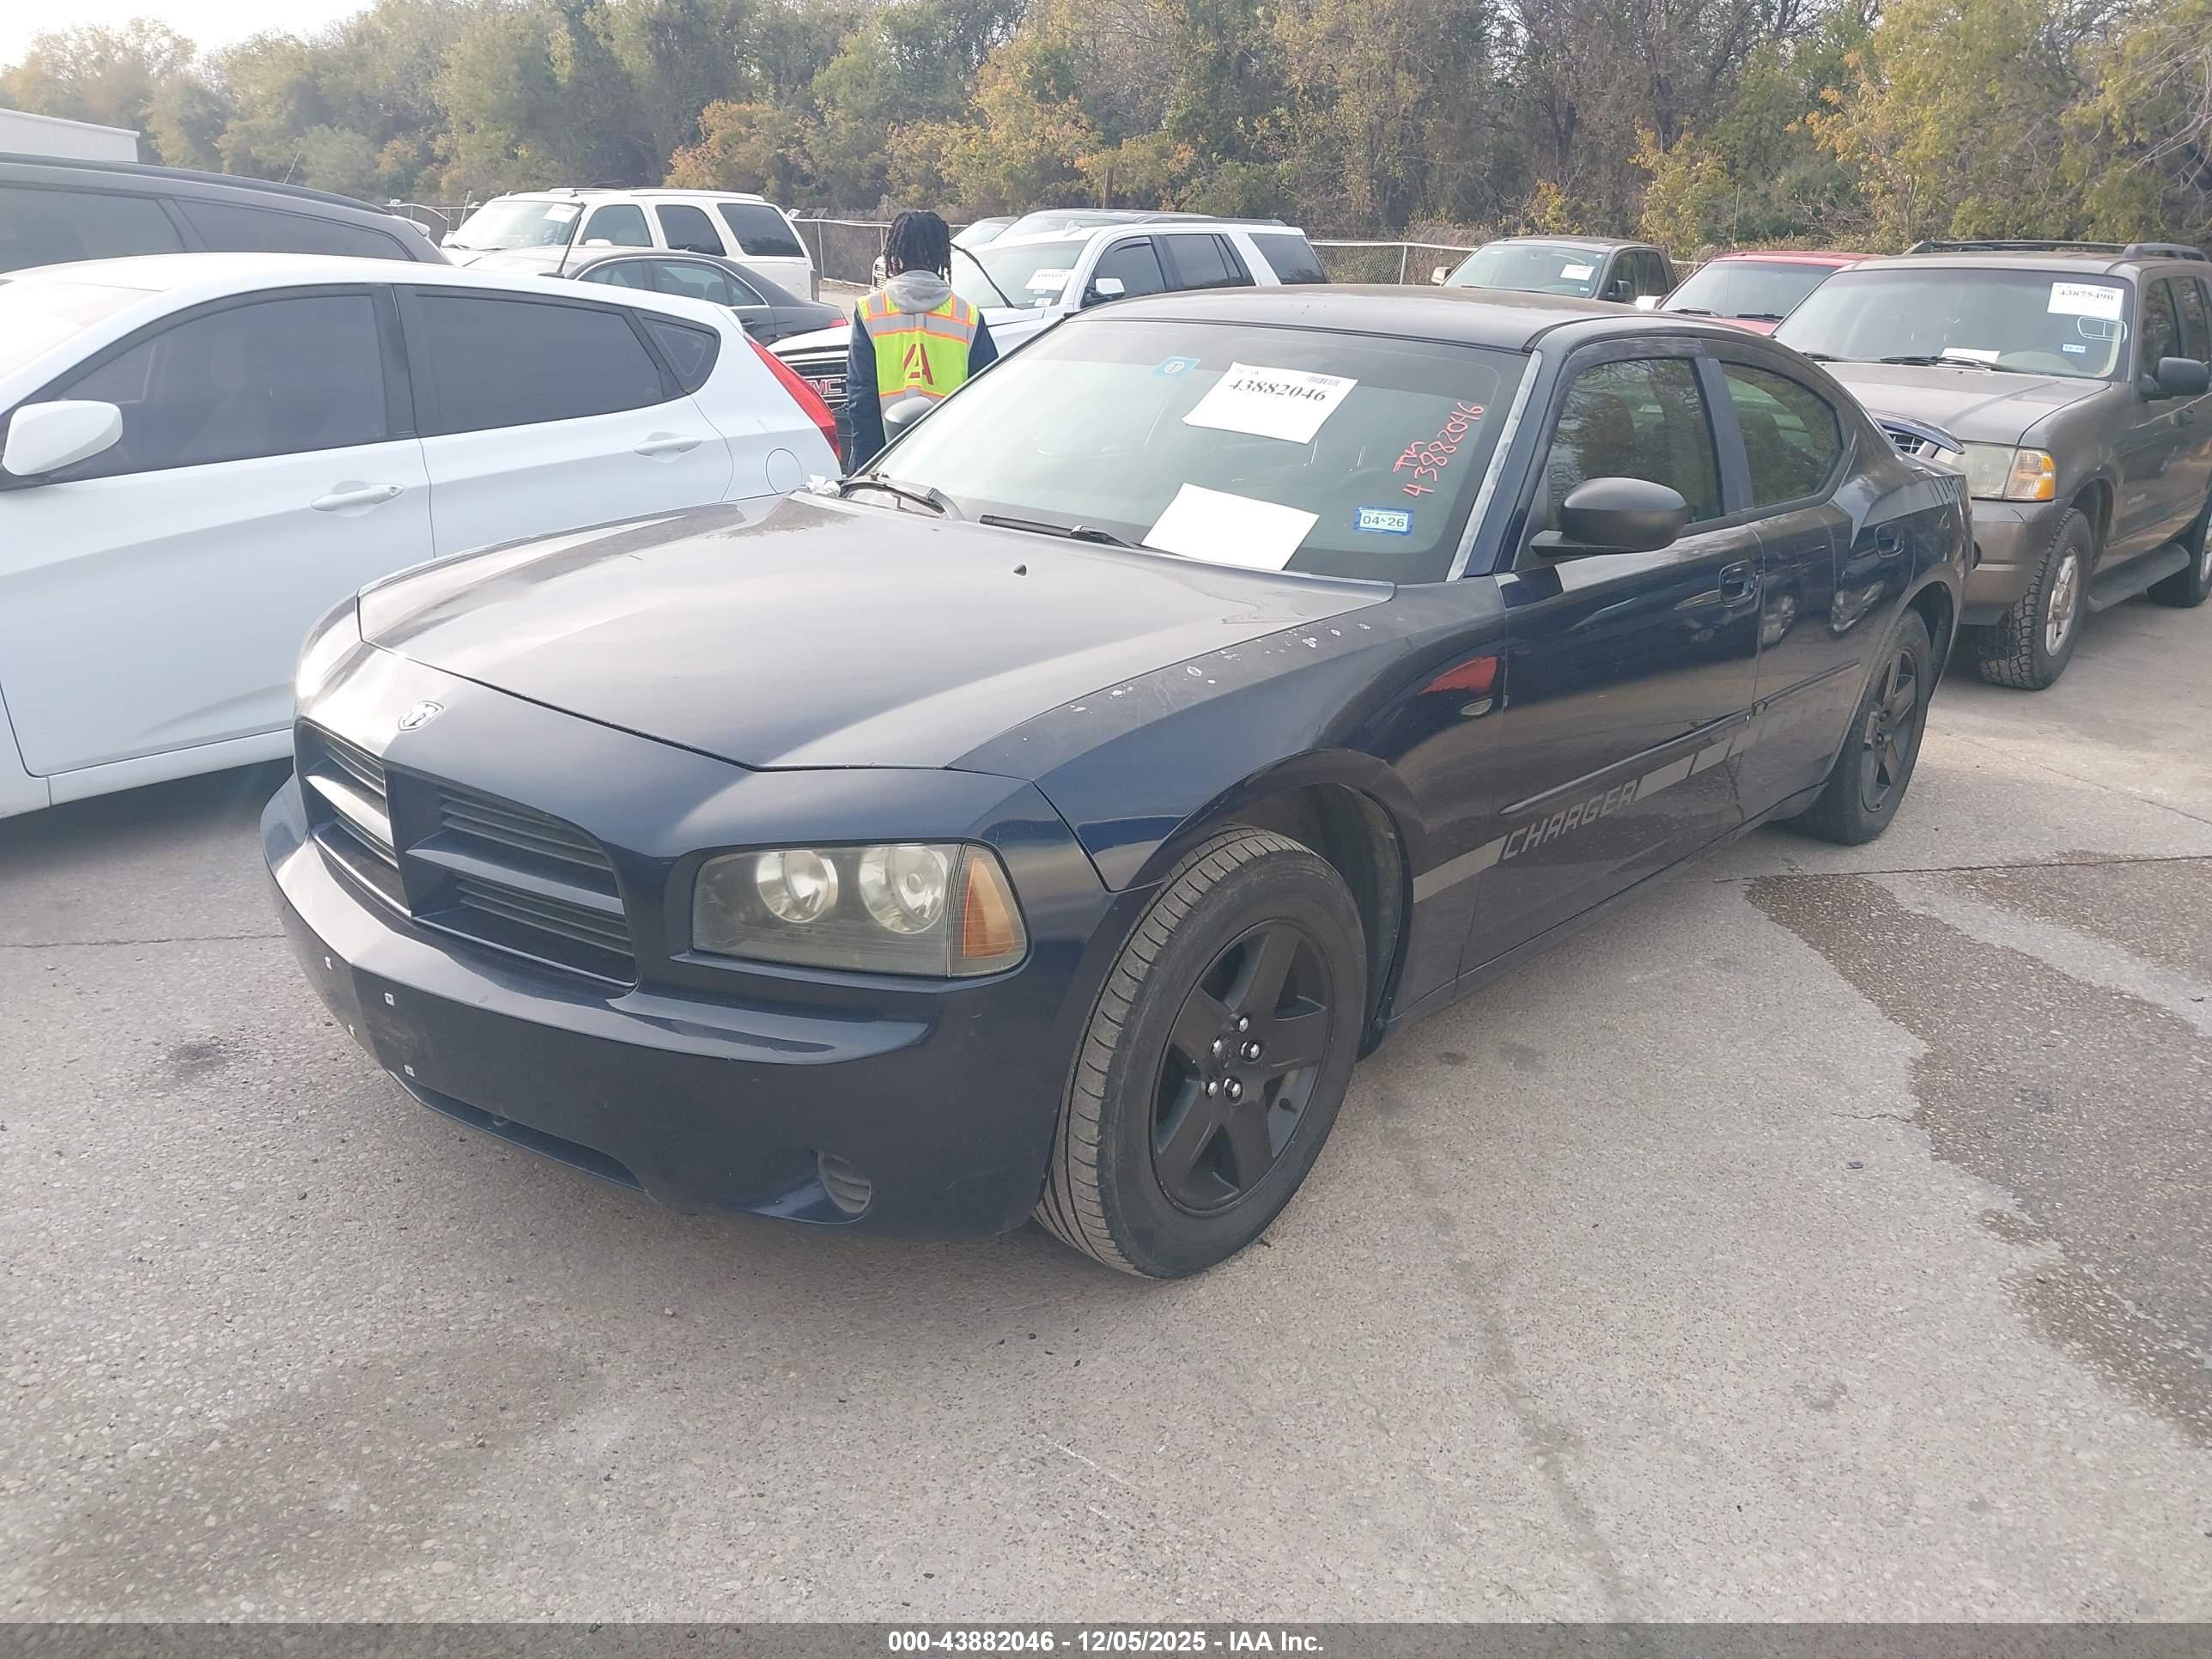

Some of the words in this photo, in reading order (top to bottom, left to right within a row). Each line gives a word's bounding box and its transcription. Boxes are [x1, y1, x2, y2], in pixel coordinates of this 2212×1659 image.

[807, 379, 842, 394] MC
[1230, 380, 1329, 402] 43882046
[1401, 401, 1485, 496] 43882046
[1503, 779, 1638, 860] CHARGER
